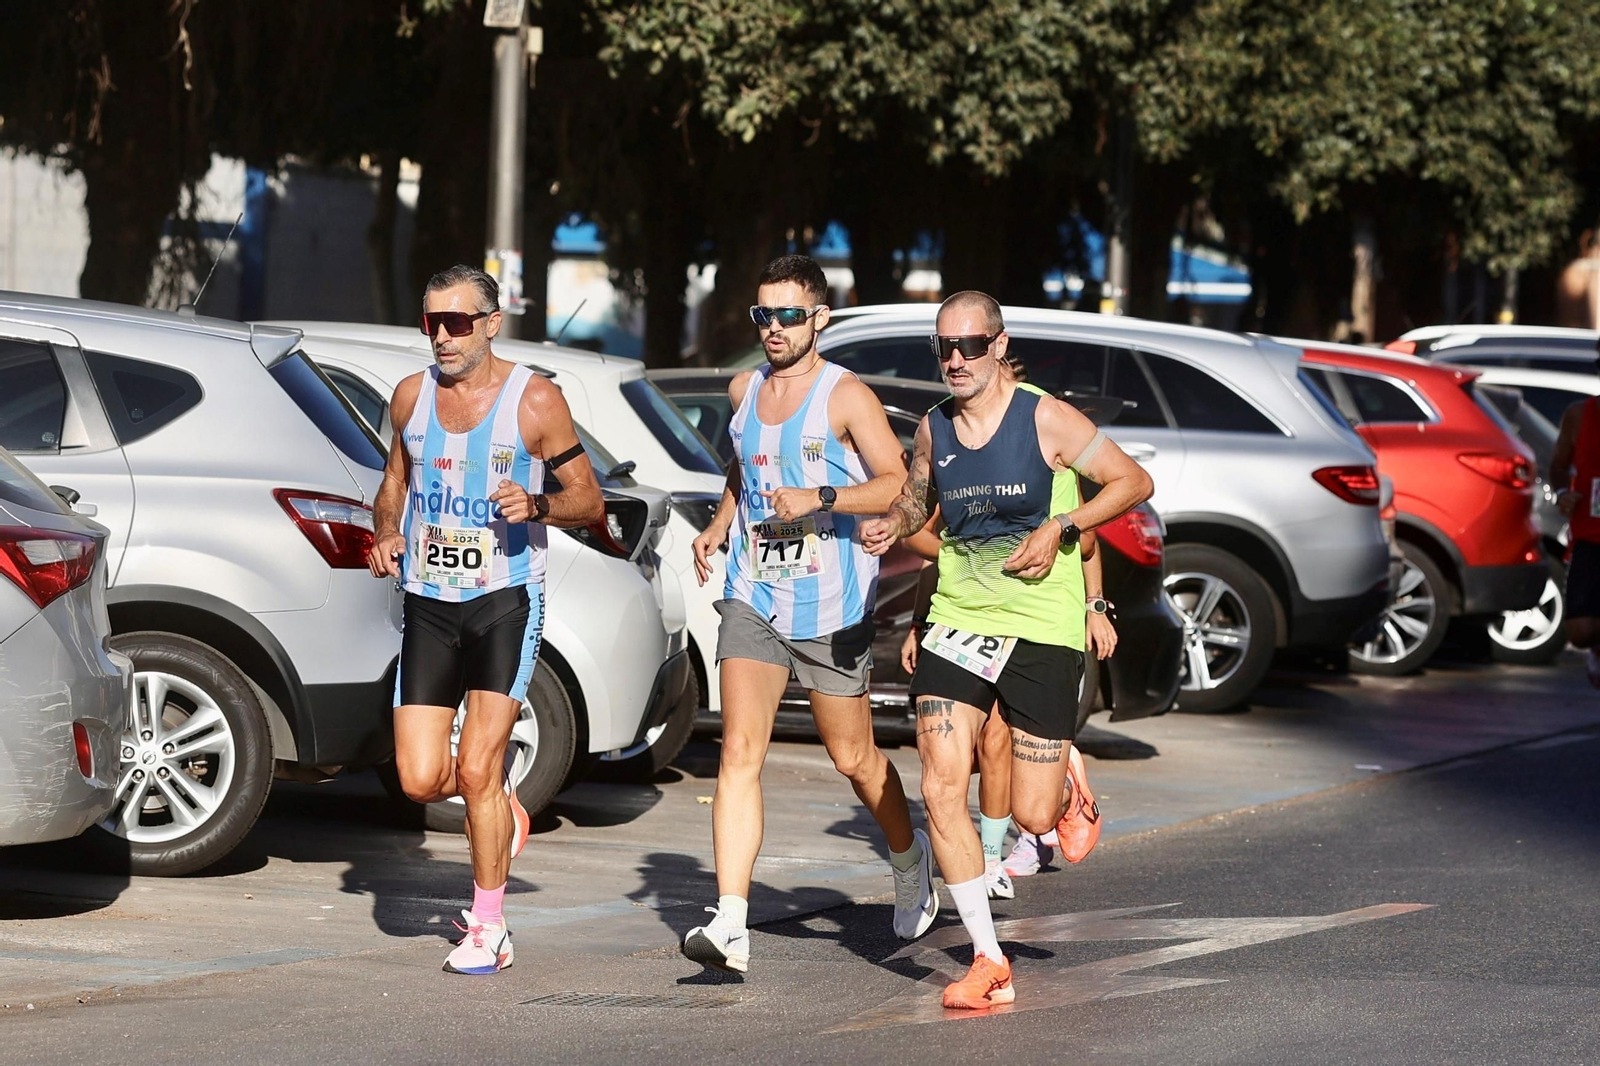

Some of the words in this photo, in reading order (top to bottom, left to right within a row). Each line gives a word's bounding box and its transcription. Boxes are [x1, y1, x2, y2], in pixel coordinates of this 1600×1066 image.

[943, 485, 992, 501] TRAINING
[995, 483, 1027, 496] THAI
[780, 526, 804, 537] 2025
[427, 543, 482, 569] 250
[759, 539, 804, 562] 717
